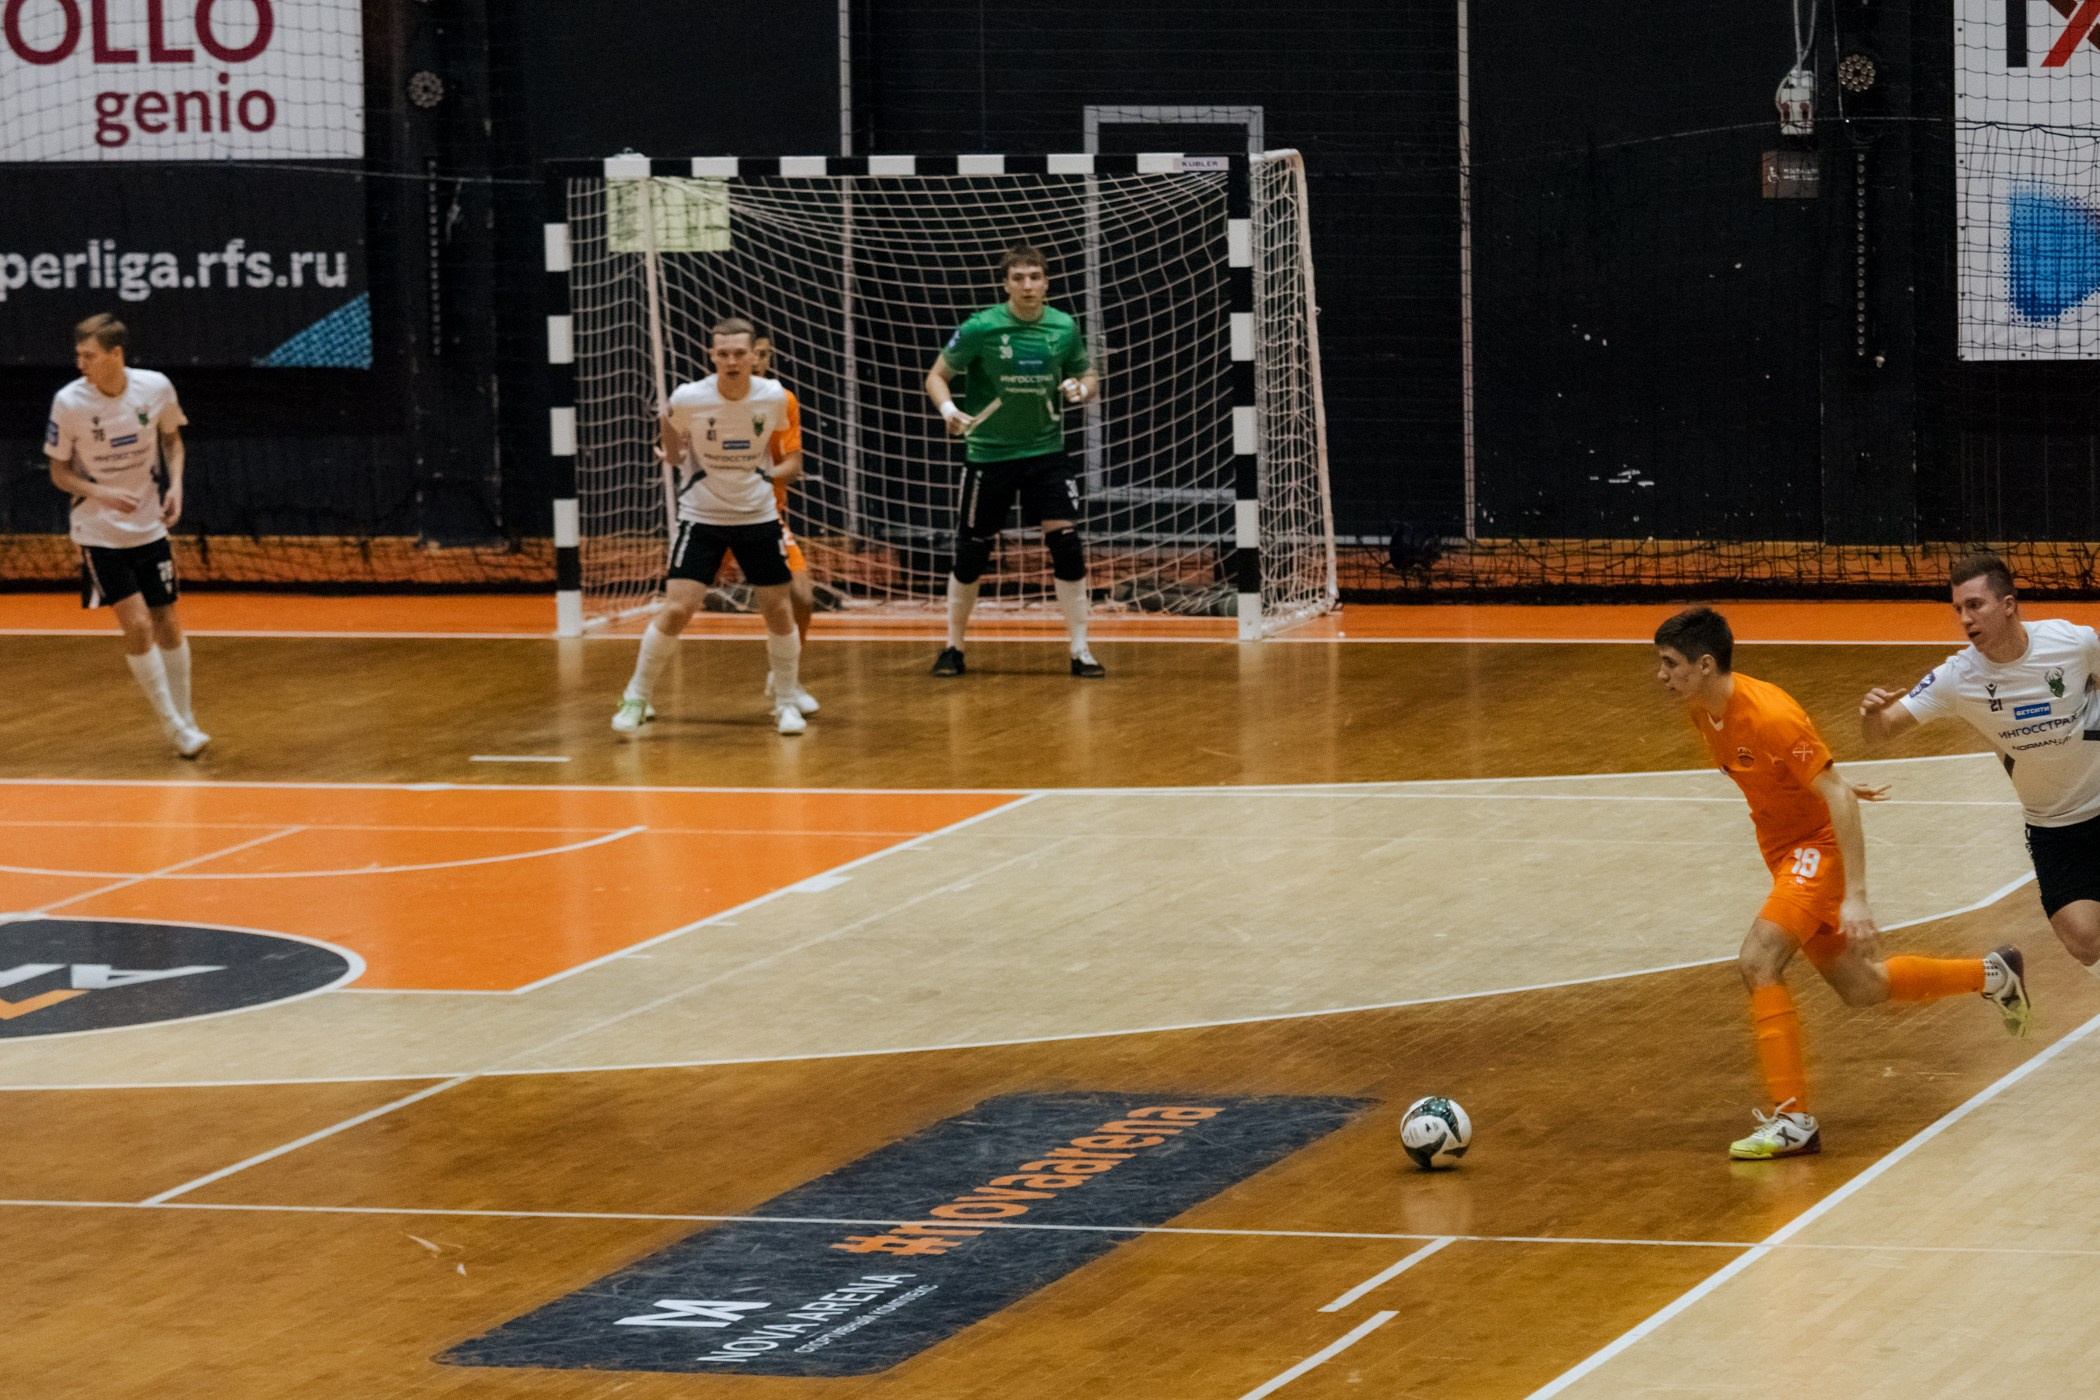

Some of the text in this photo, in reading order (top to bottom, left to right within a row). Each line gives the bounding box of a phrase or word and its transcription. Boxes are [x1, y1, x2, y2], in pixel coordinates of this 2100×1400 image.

[3, 0, 275, 65] OLLO
[94, 71, 276, 148] genio
[0, 238, 347, 301] perliga.rfs.ru
[1989, 698, 2003, 712] 21
[1998, 713, 2078, 740] ИНГОССТРАХ
[2012, 738, 2057, 751] NORMAN
[1791, 848, 1821, 878] 18
[829, 1106, 1227, 1256] #novaarena
[696, 1273, 917, 1362] NOVA ARENA
